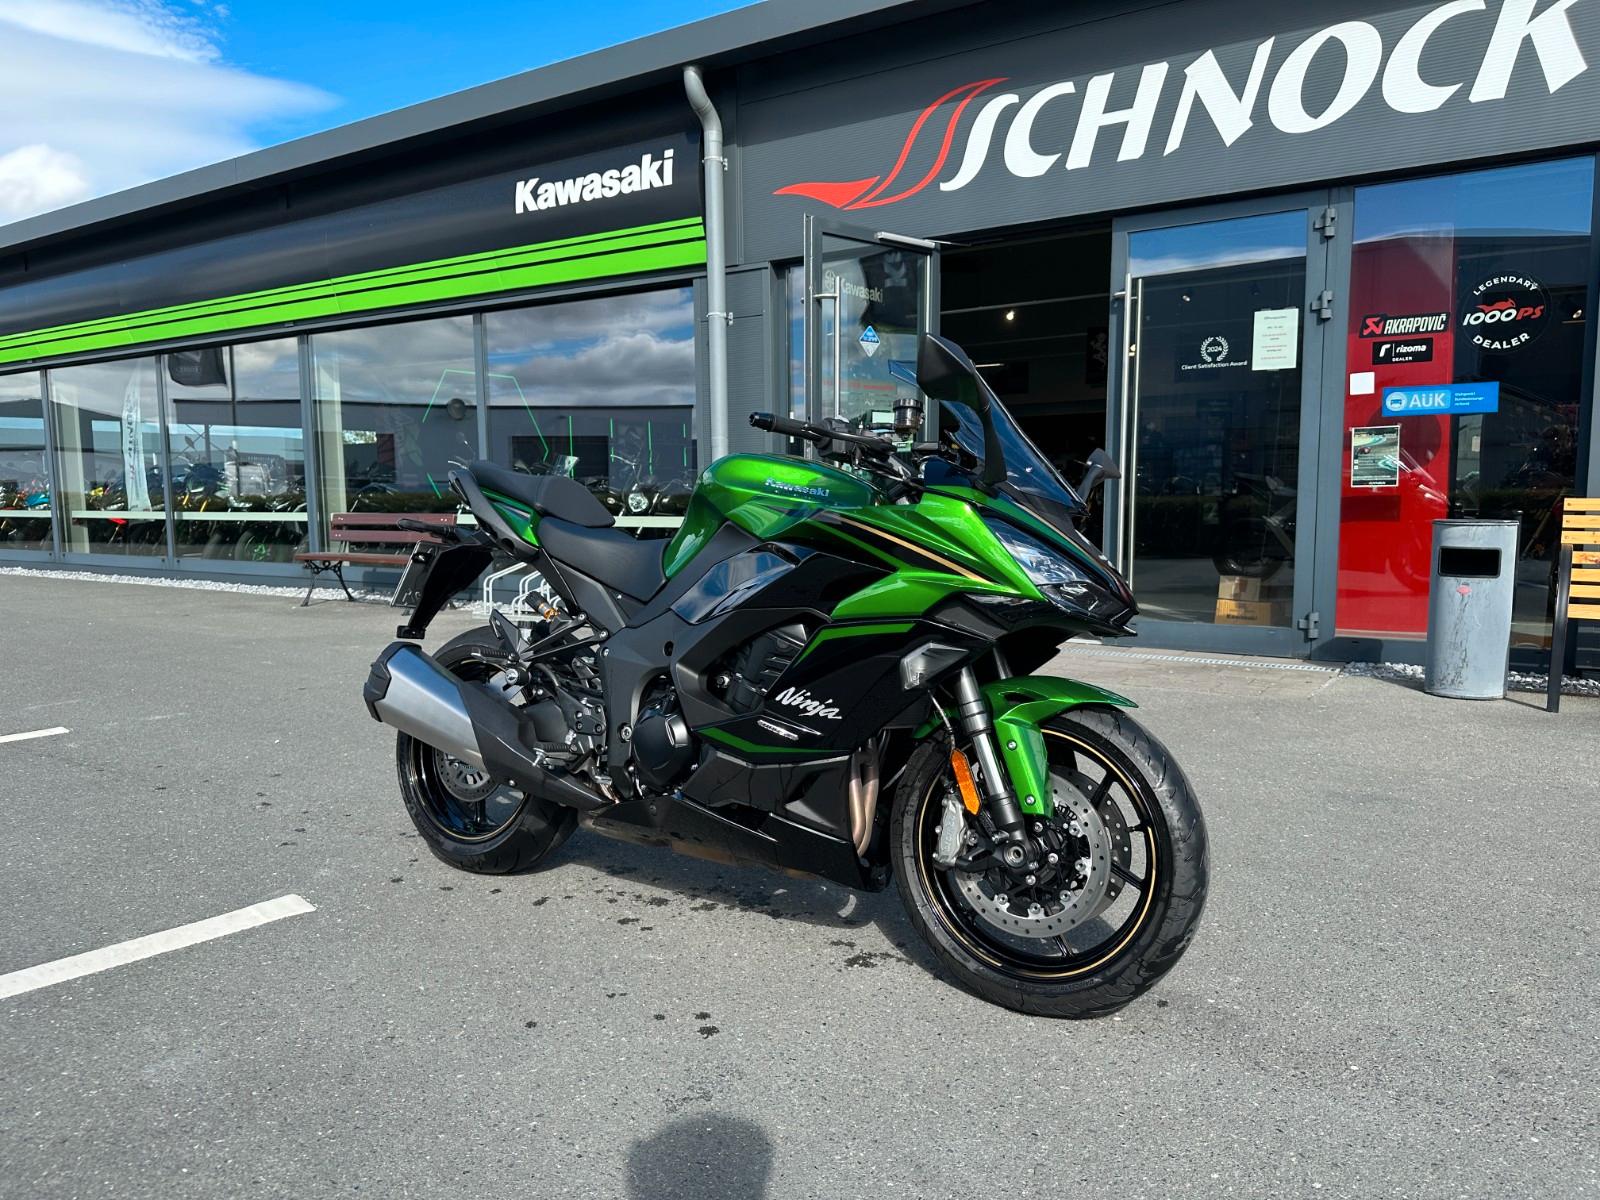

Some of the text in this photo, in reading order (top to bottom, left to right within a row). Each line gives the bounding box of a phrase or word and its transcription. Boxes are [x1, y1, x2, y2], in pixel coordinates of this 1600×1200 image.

[939, 0, 1588, 191] SCHNOCK
[515, 149, 674, 214] Kawasaki
[1473, 276, 1538, 296] LEGENDARY
[1462, 305, 1545, 326] 1000PS
[1396, 344, 1427, 353] rizoma
[1473, 332, 1530, 349] DEALER
[775, 687, 843, 719] Ninja
